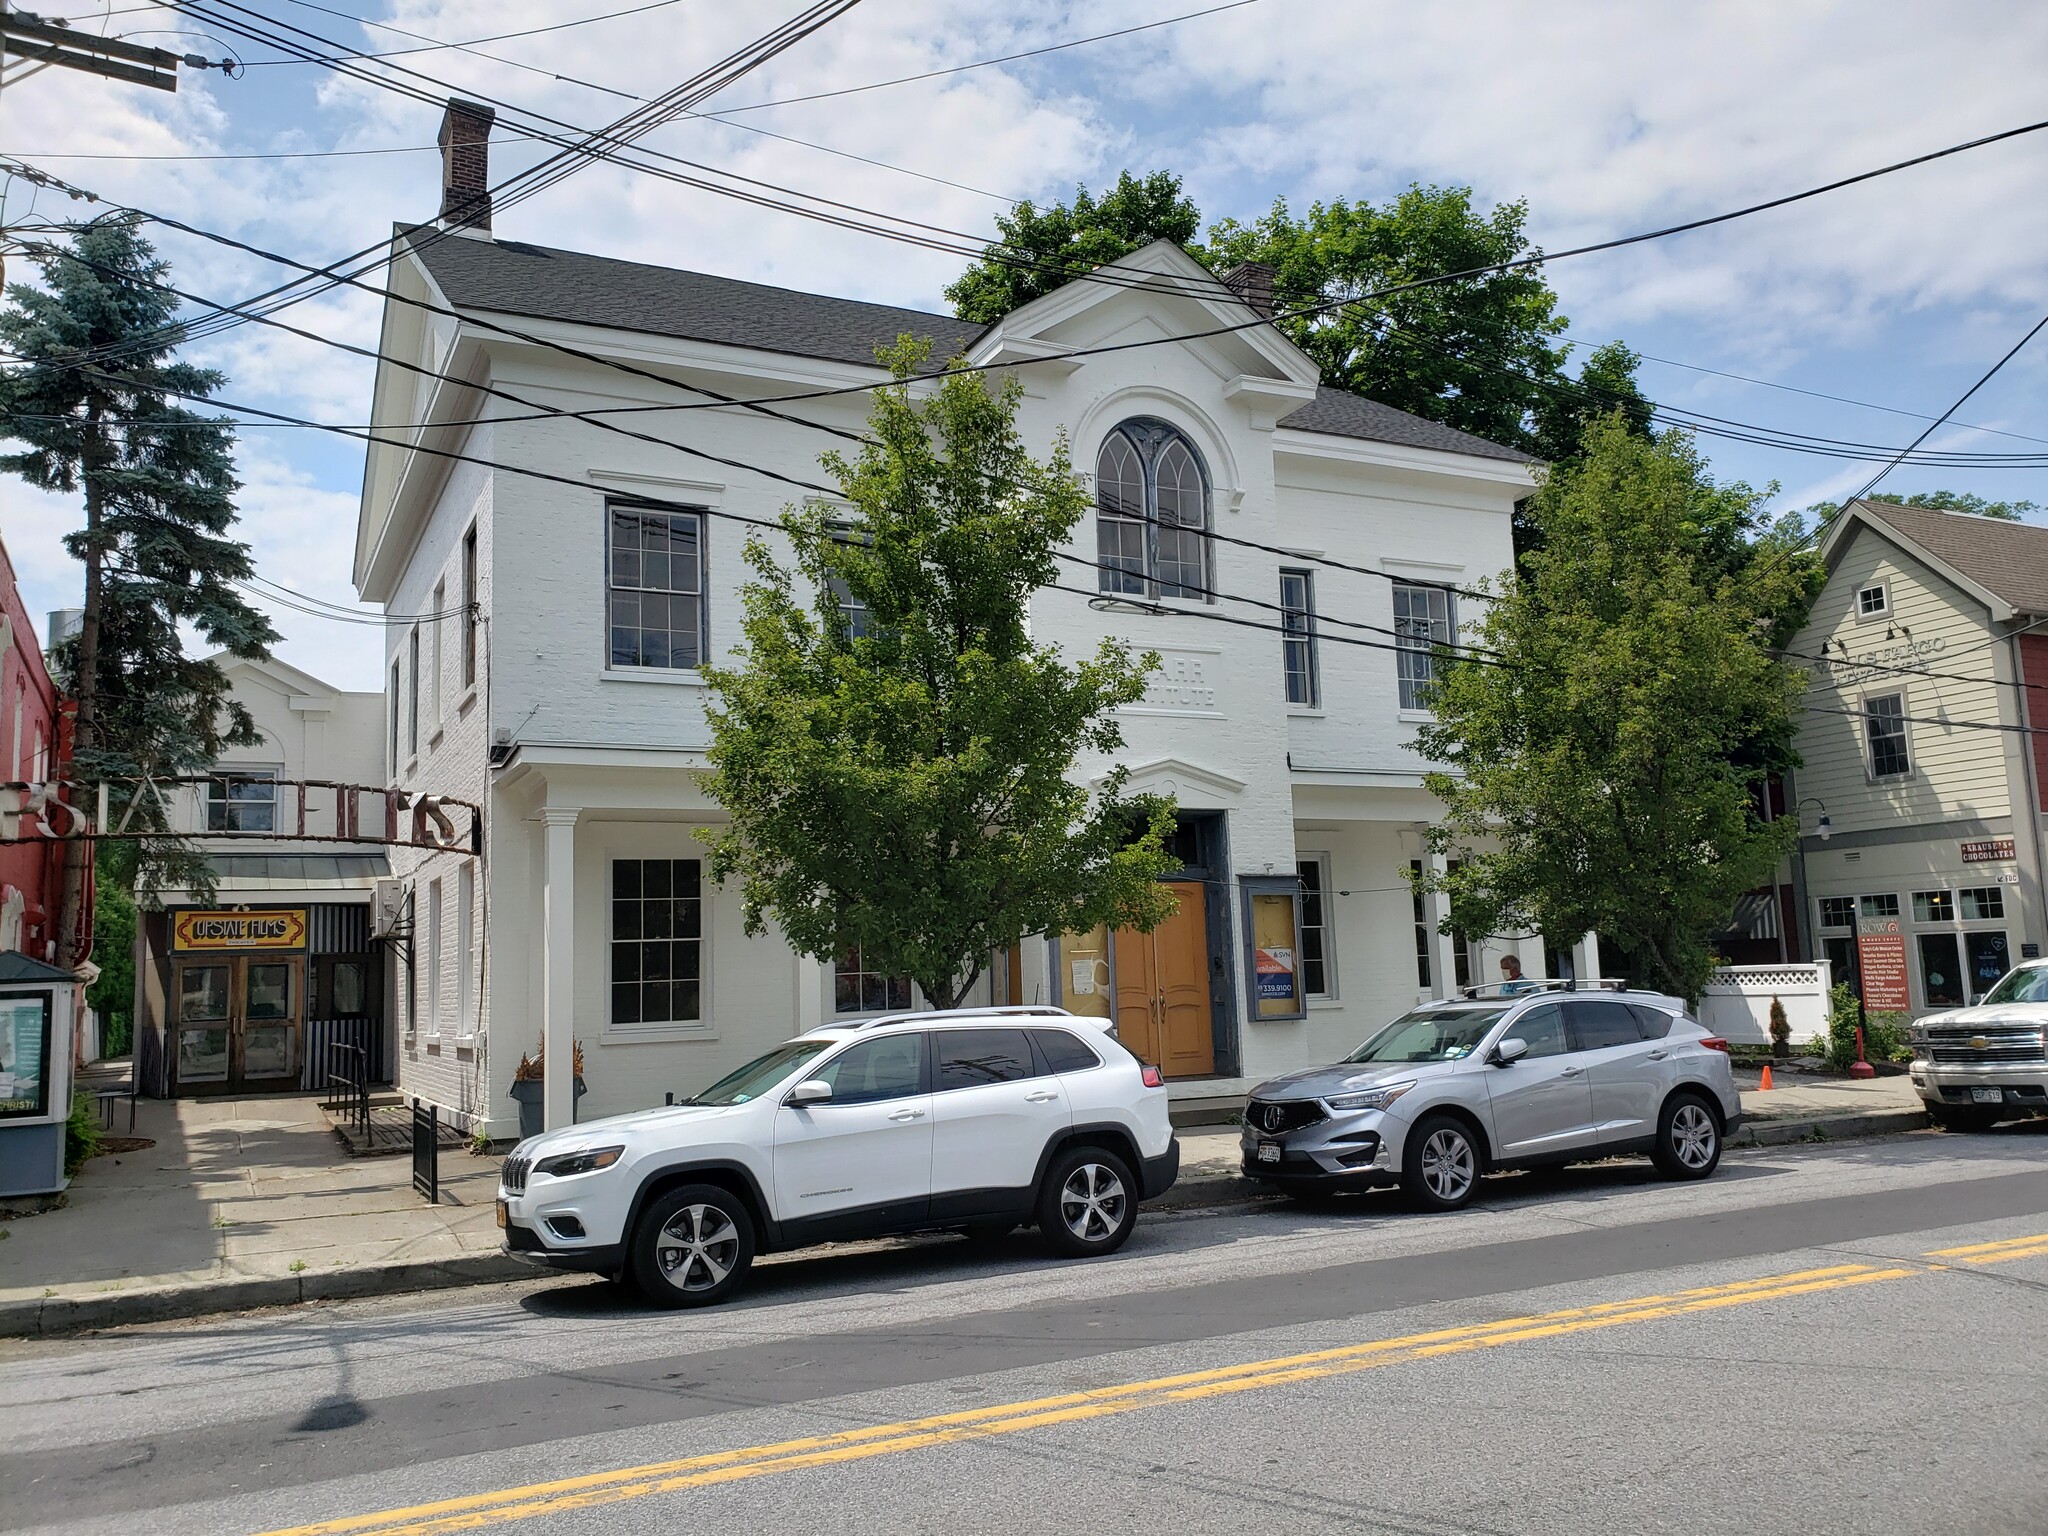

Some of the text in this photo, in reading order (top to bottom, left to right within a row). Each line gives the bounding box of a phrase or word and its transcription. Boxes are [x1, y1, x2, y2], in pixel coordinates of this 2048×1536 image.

[1966, 841, 2008, 851] KRAUSE'S
[1963, 850, 2014, 861] CHOCOLATES
[2005, 874, 2017, 883] FDC
[195, 918, 288, 937] UPSTATE FILMS
[1861, 922, 1887, 933] ROW
